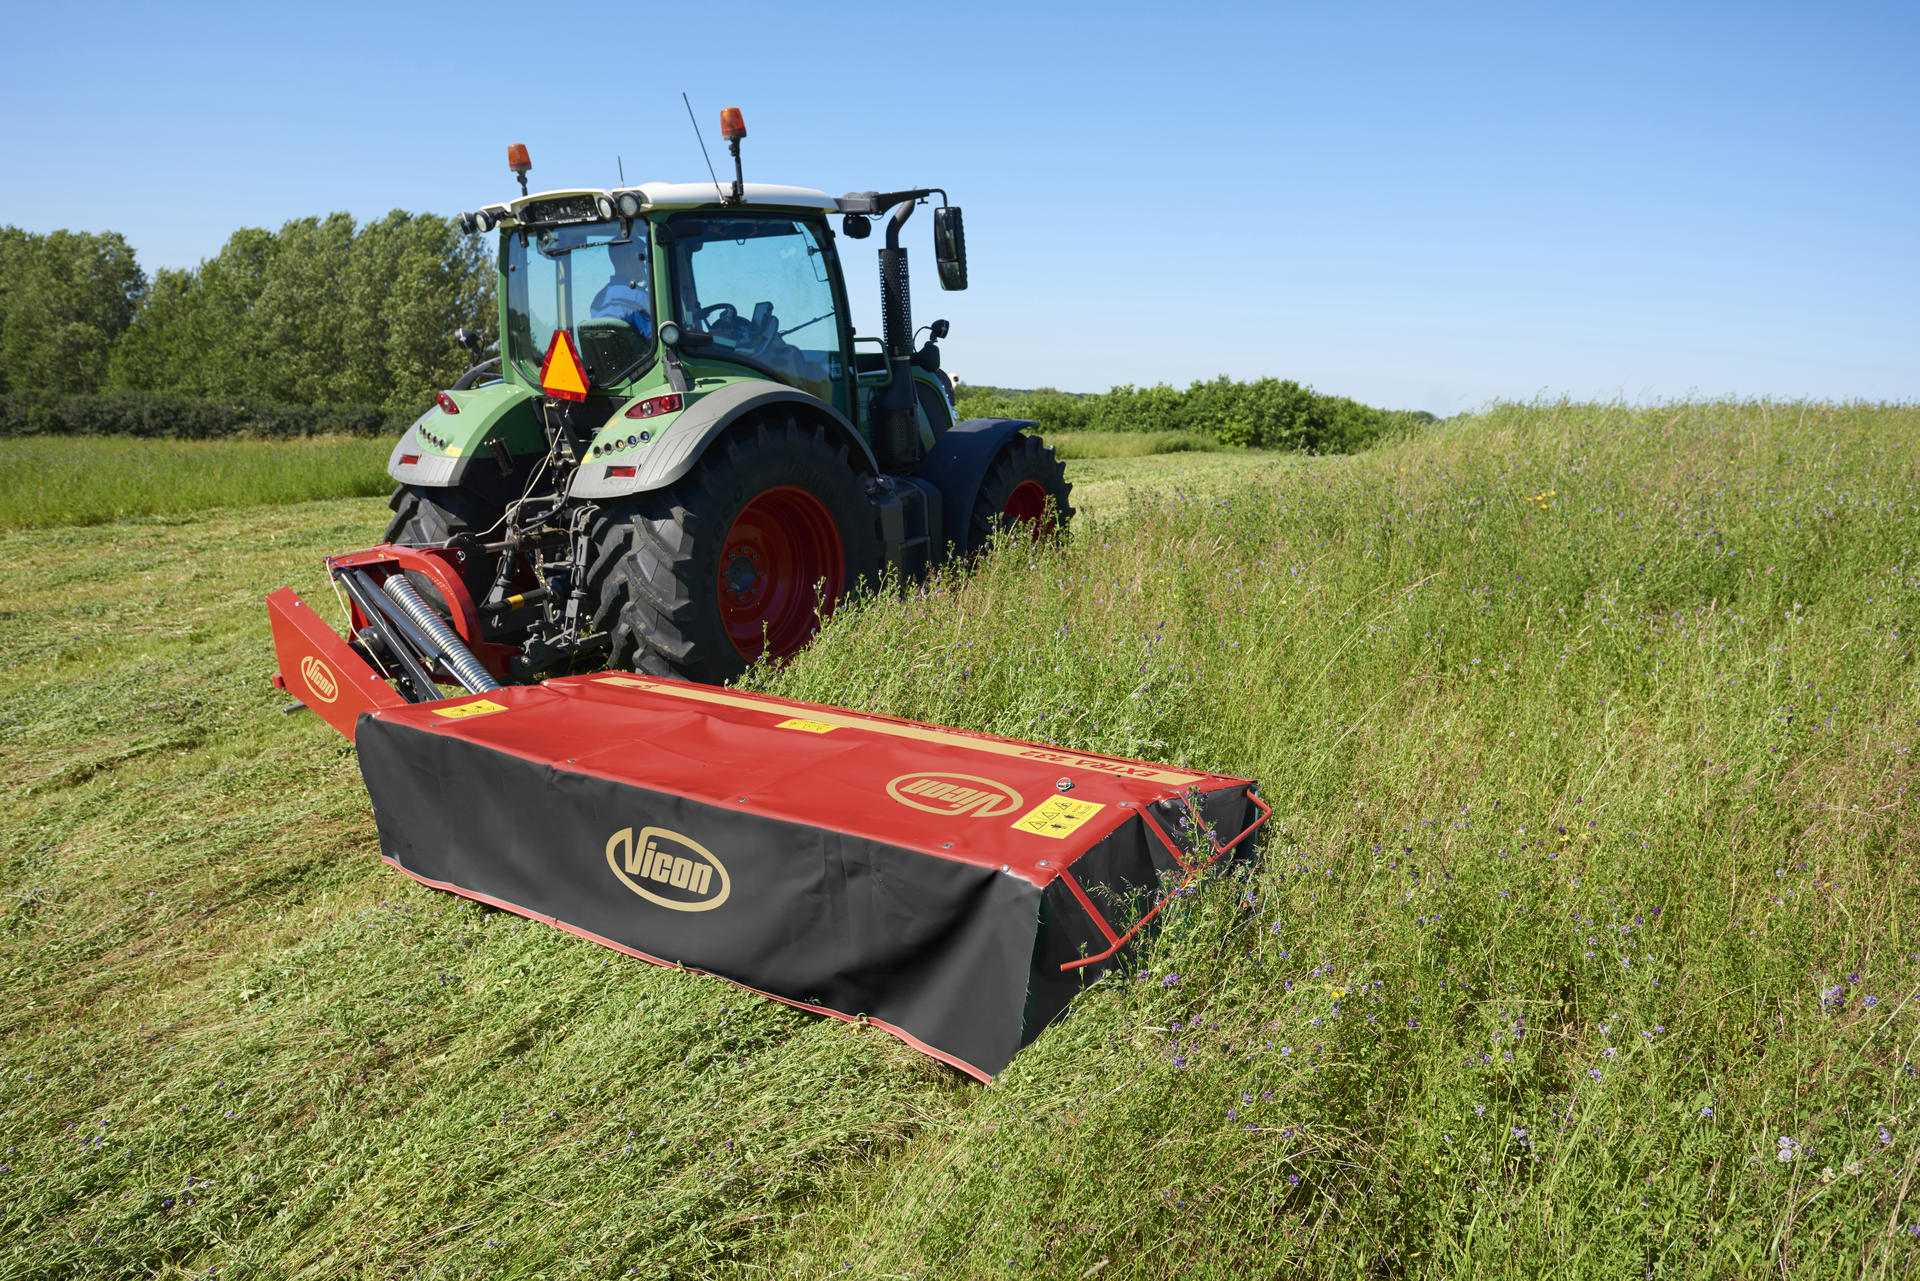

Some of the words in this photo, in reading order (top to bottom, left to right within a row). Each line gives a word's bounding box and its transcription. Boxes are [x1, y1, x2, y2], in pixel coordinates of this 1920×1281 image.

[304, 656, 336, 698] Vicon
[1075, 760, 1160, 777] EXTRA
[898, 777, 1009, 817] Vicon
[621, 826, 717, 897] Vicon
